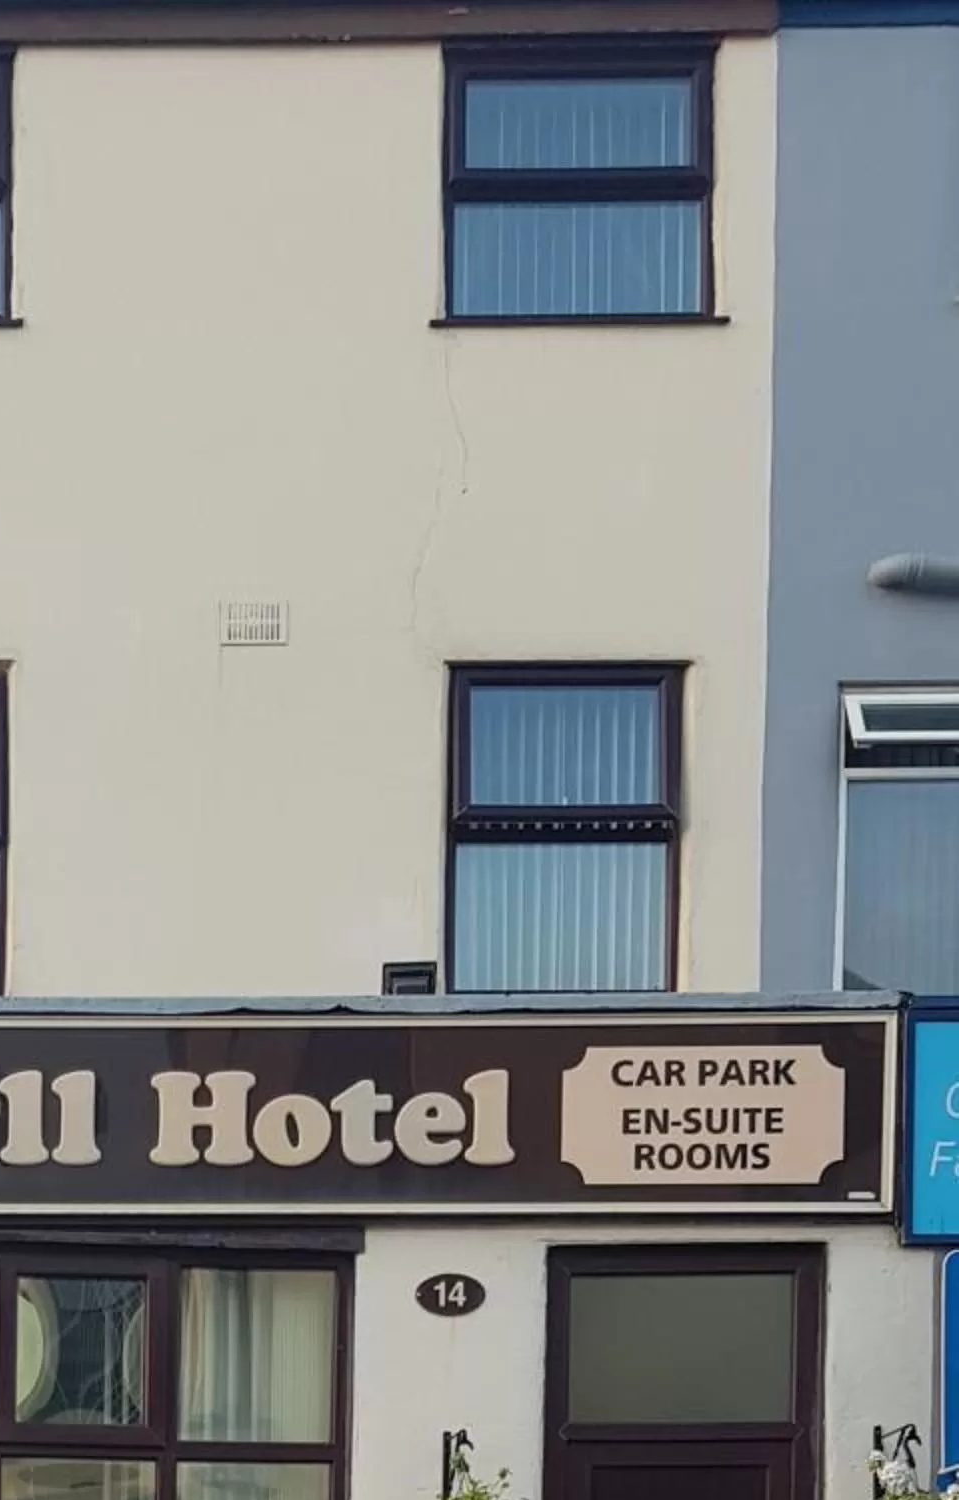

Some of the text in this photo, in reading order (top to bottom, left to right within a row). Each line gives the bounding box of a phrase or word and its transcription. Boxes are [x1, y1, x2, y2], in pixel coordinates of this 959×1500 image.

[610, 1058, 798, 1087] CAR PARK
[148, 1068, 516, 1168] Hotel
[621, 1106, 785, 1135] EN-SUITE
[634, 1142, 771, 1171] ROOMS
[433, 1280, 467, 1308] 14
